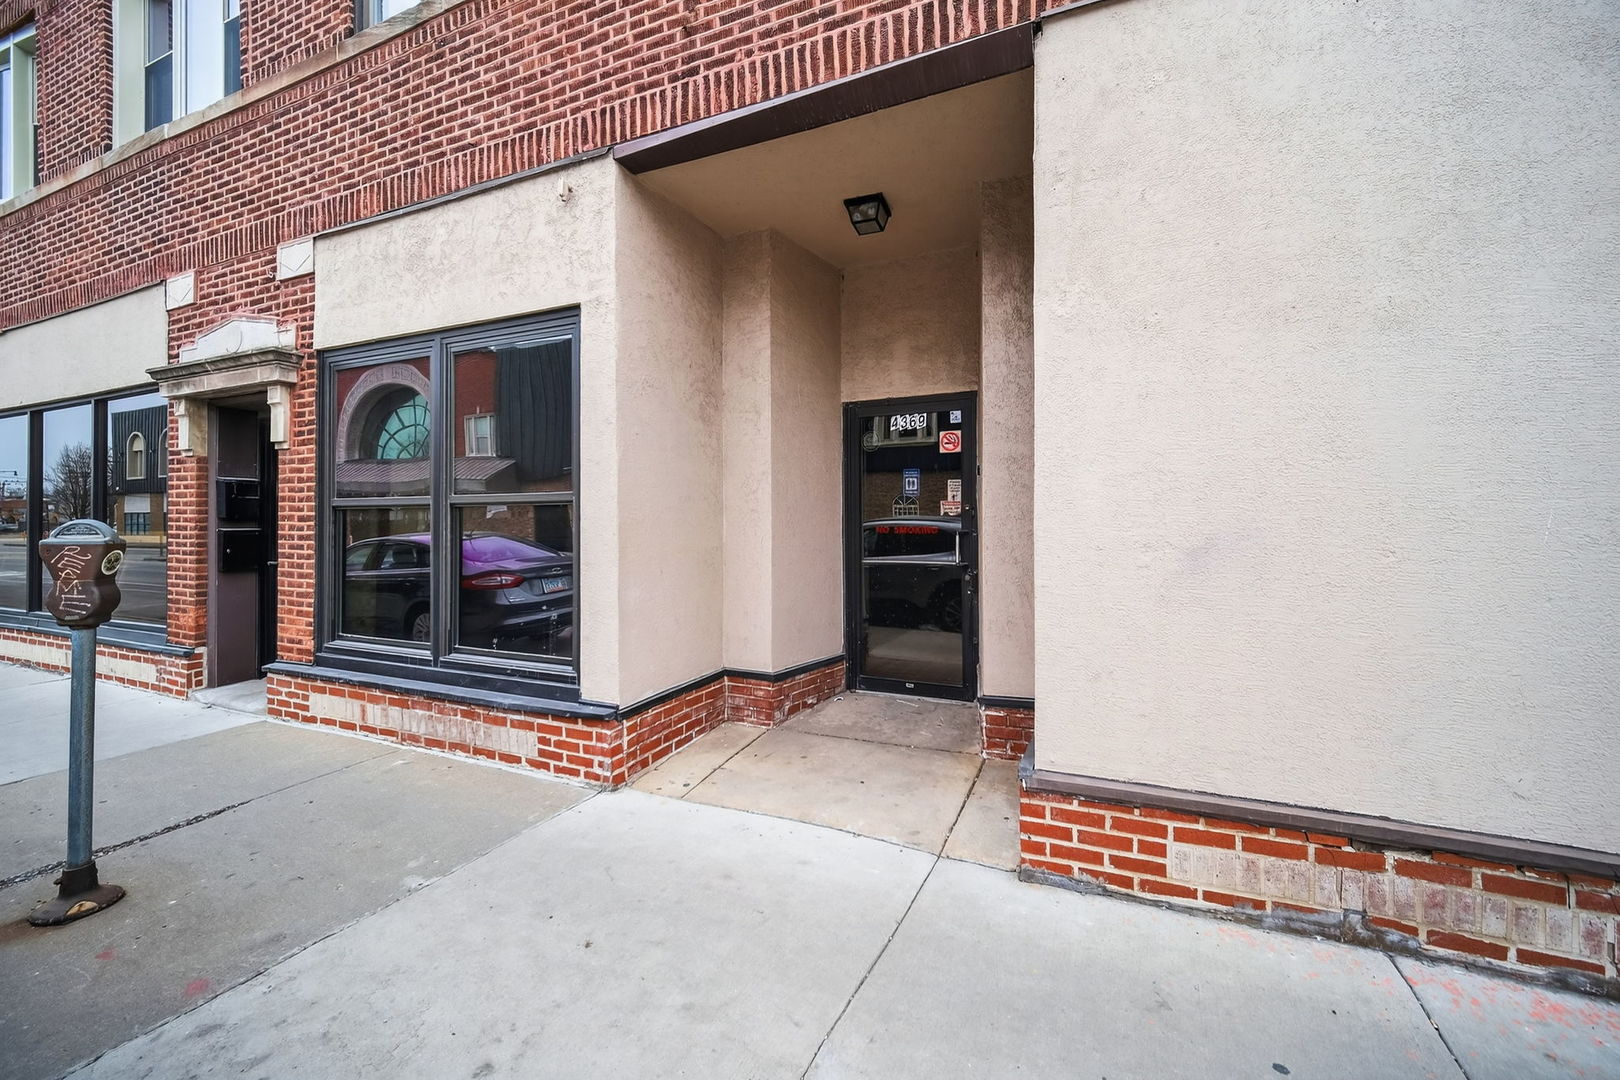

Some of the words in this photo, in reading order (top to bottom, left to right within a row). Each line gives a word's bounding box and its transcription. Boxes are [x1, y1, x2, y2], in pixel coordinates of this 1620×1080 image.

[891, 413, 926, 430] 4369
[875, 526, 889, 534] NO
[894, 526, 938, 534] SMOKING
